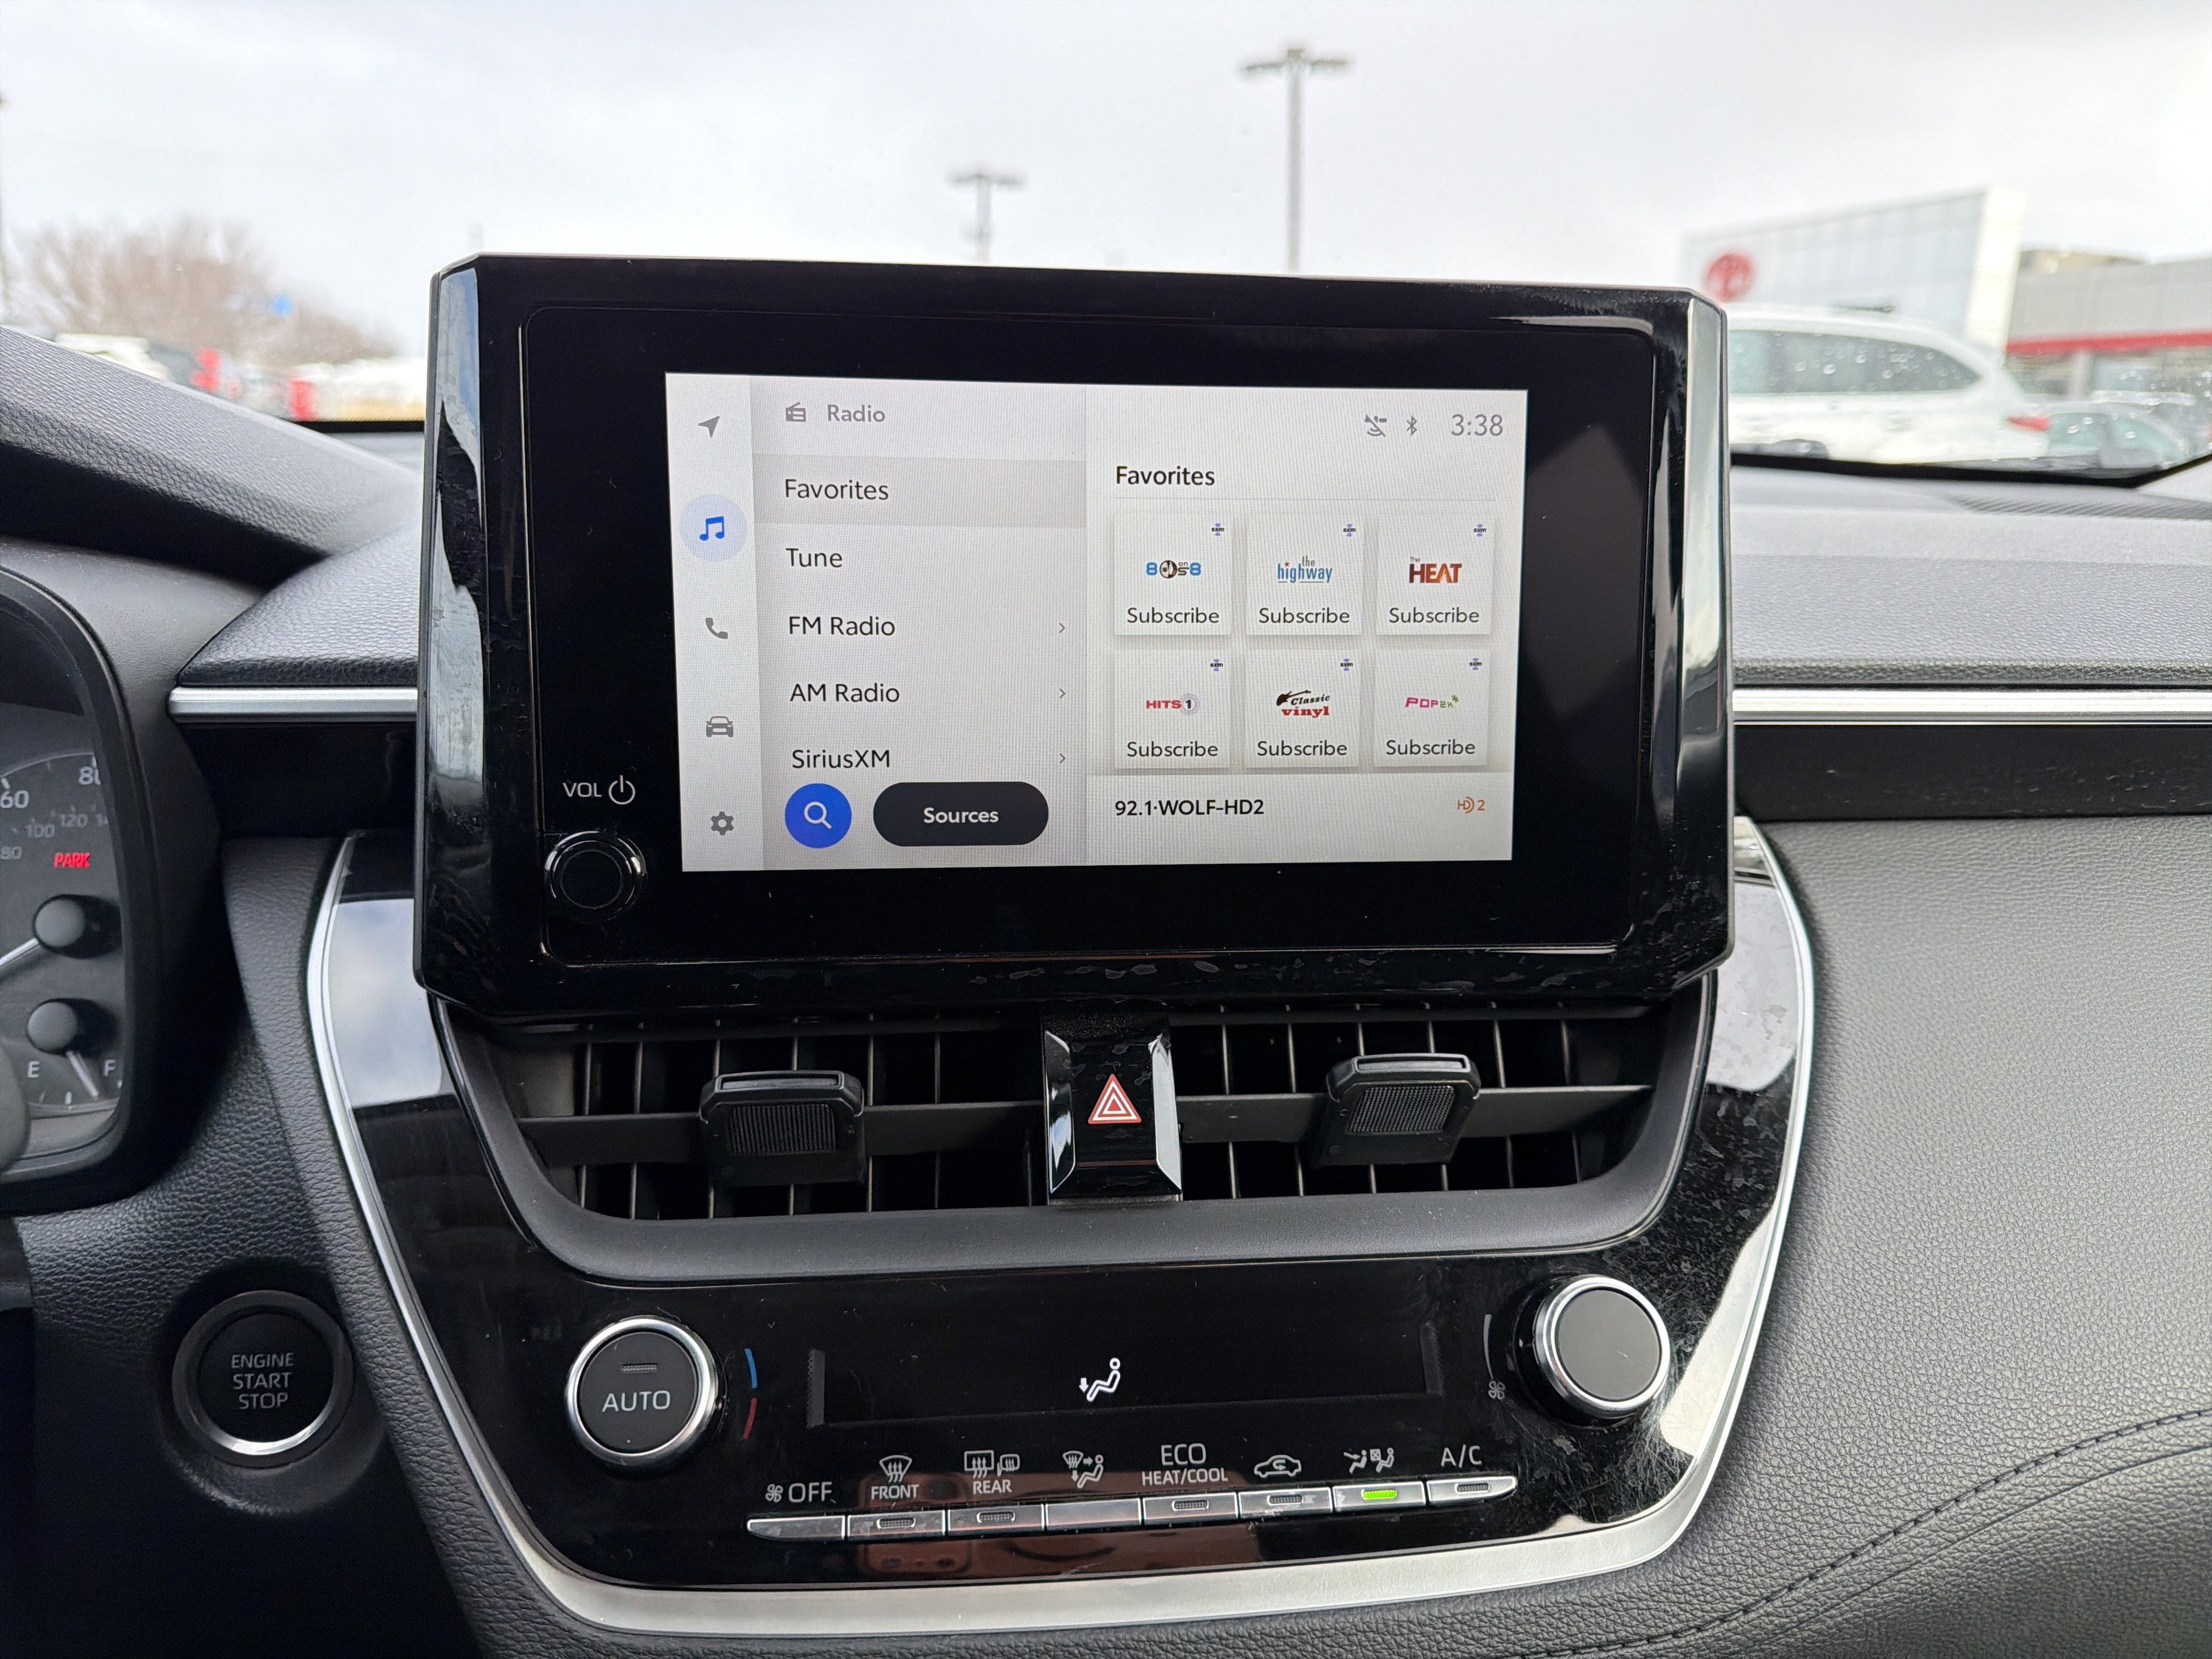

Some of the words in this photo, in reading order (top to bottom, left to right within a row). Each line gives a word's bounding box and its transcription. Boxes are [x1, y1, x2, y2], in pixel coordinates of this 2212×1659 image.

[827, 404, 886, 423] Radio
[1451, 414, 1504, 437] 3:38
[1115, 465, 1216, 486] Favorites
[785, 478, 889, 500] Favorites
[786, 548, 844, 568] Tune
[1302, 555, 1315, 567] the
[1277, 562, 1333, 584] highway
[1408, 563, 1463, 584] HEAT
[1127, 607, 1220, 624] Subscribe
[1258, 607, 1351, 624] Subscribe
[1389, 607, 1480, 624] Subscribe
[789, 616, 822, 636] FM
[830, 616, 896, 636] Radio
[790, 684, 827, 703] AM
[836, 682, 900, 703] Radio
[1290, 694, 1331, 706] Classic
[1146, 699, 1182, 709] HITS
[1281, 706, 1330, 719] vinyl
[1127, 741, 1219, 758] Subscribe
[1256, 740, 1348, 757] Subscribe
[1385, 739, 1476, 756] Subscribe
[791, 749, 891, 769] SiriusXM
[562, 782, 602, 798] VOL
[0, 790, 29, 809] 60
[1477, 799, 1485, 810] 2
[923, 807, 1000, 824] Sources
[53, 851, 91, 868] PARK
[27, 1060, 40, 1079] E
[103, 1059, 117, 1076] F
[231, 1352, 295, 1369] ENGINE
[233, 1372, 292, 1390] START
[238, 1392, 289, 1409] STOP
[602, 1390, 671, 1413] AUTO
[1160, 1442, 1207, 1465] ECO
[1440, 1444, 1482, 1468] A/C
[1141, 1466, 1229, 1486] HEAT/COOL
[788, 1481, 833, 1504] OFF
[871, 1484, 919, 1500] FRONT
[973, 1479, 1012, 1496] REAR
